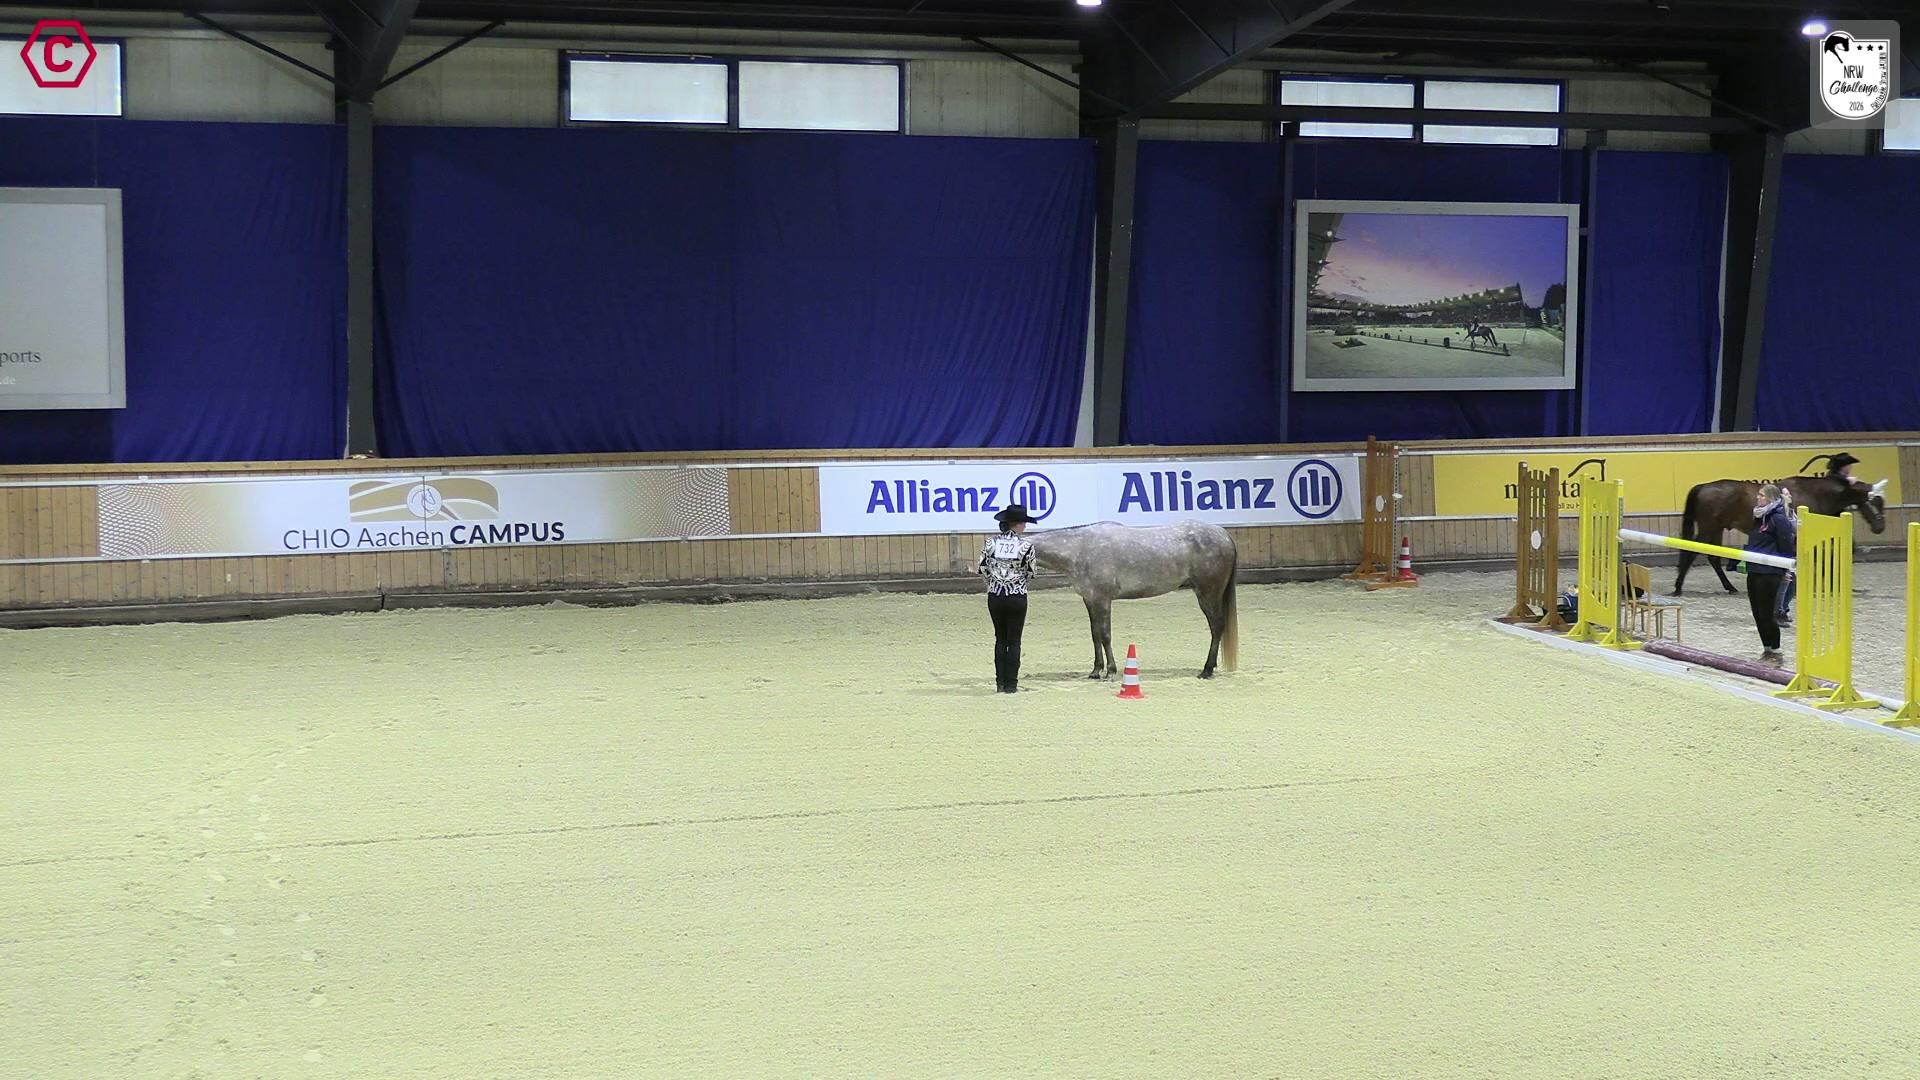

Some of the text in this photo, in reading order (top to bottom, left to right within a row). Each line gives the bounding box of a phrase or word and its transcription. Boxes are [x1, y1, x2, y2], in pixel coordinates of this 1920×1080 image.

[866, 479, 1000, 513] Allianz
[1118, 470, 1276, 513] Allianz
[283, 521, 565, 550] CHIO Aachen CAMPUS
[1000, 543, 1015, 554] 732
